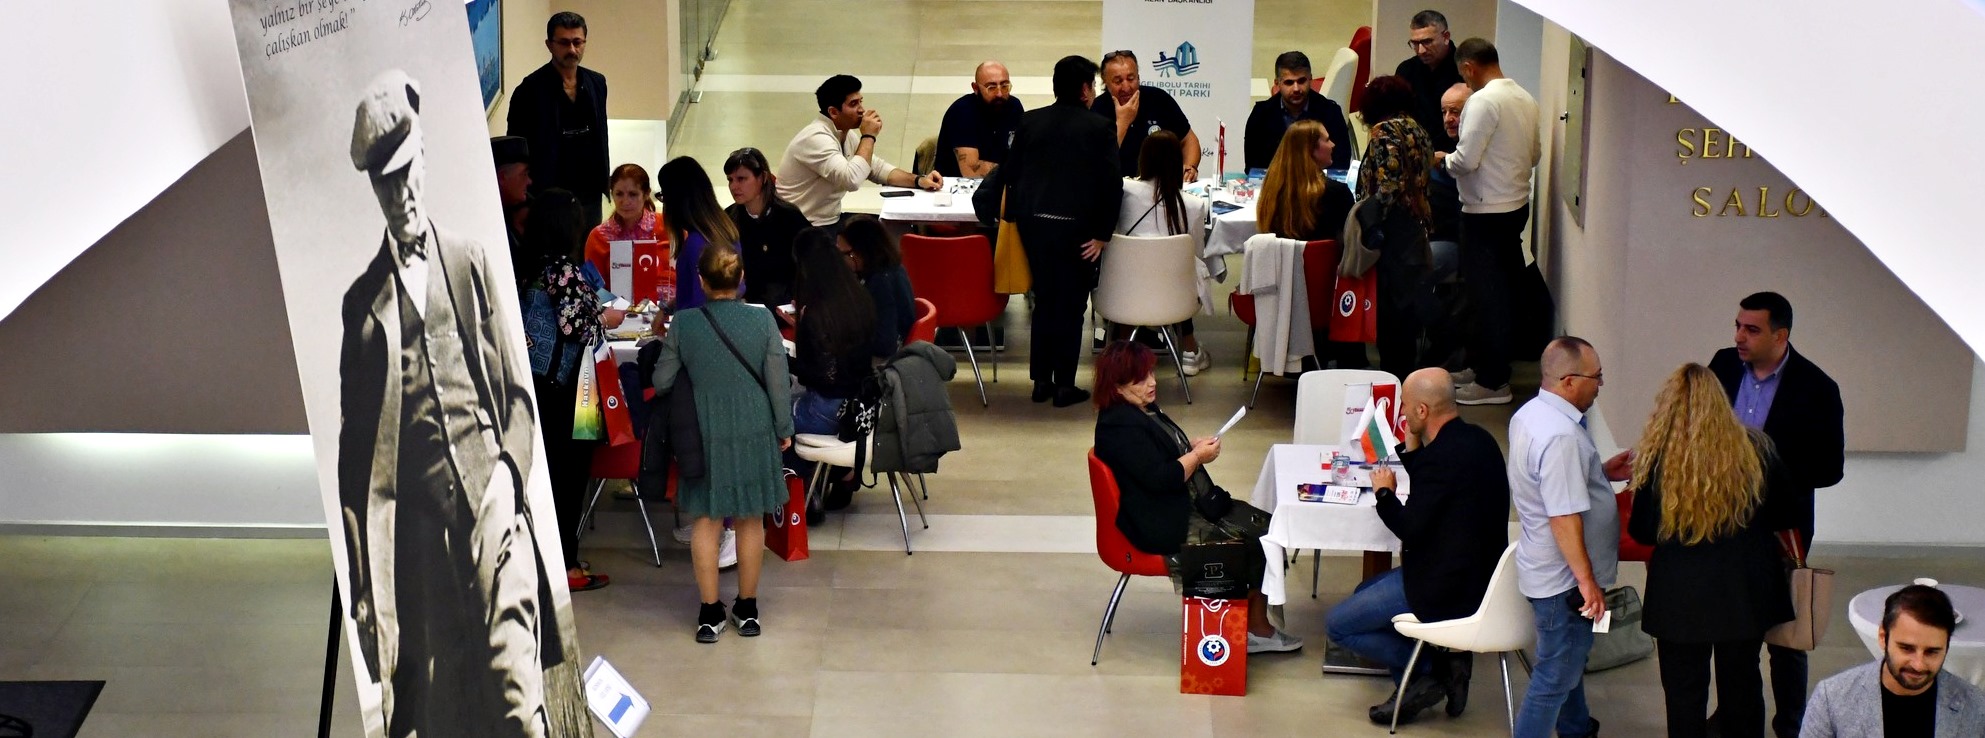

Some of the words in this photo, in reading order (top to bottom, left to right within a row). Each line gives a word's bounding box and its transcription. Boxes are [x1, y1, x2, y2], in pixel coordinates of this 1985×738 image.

[260, 5, 295, 36] yalnız
[265, 28, 311, 60] çalışkan
[1179, 89, 1211, 97] PARKI
[1676, 128, 1754, 166] ŞEH
[1692, 187, 1828, 218] SALO
